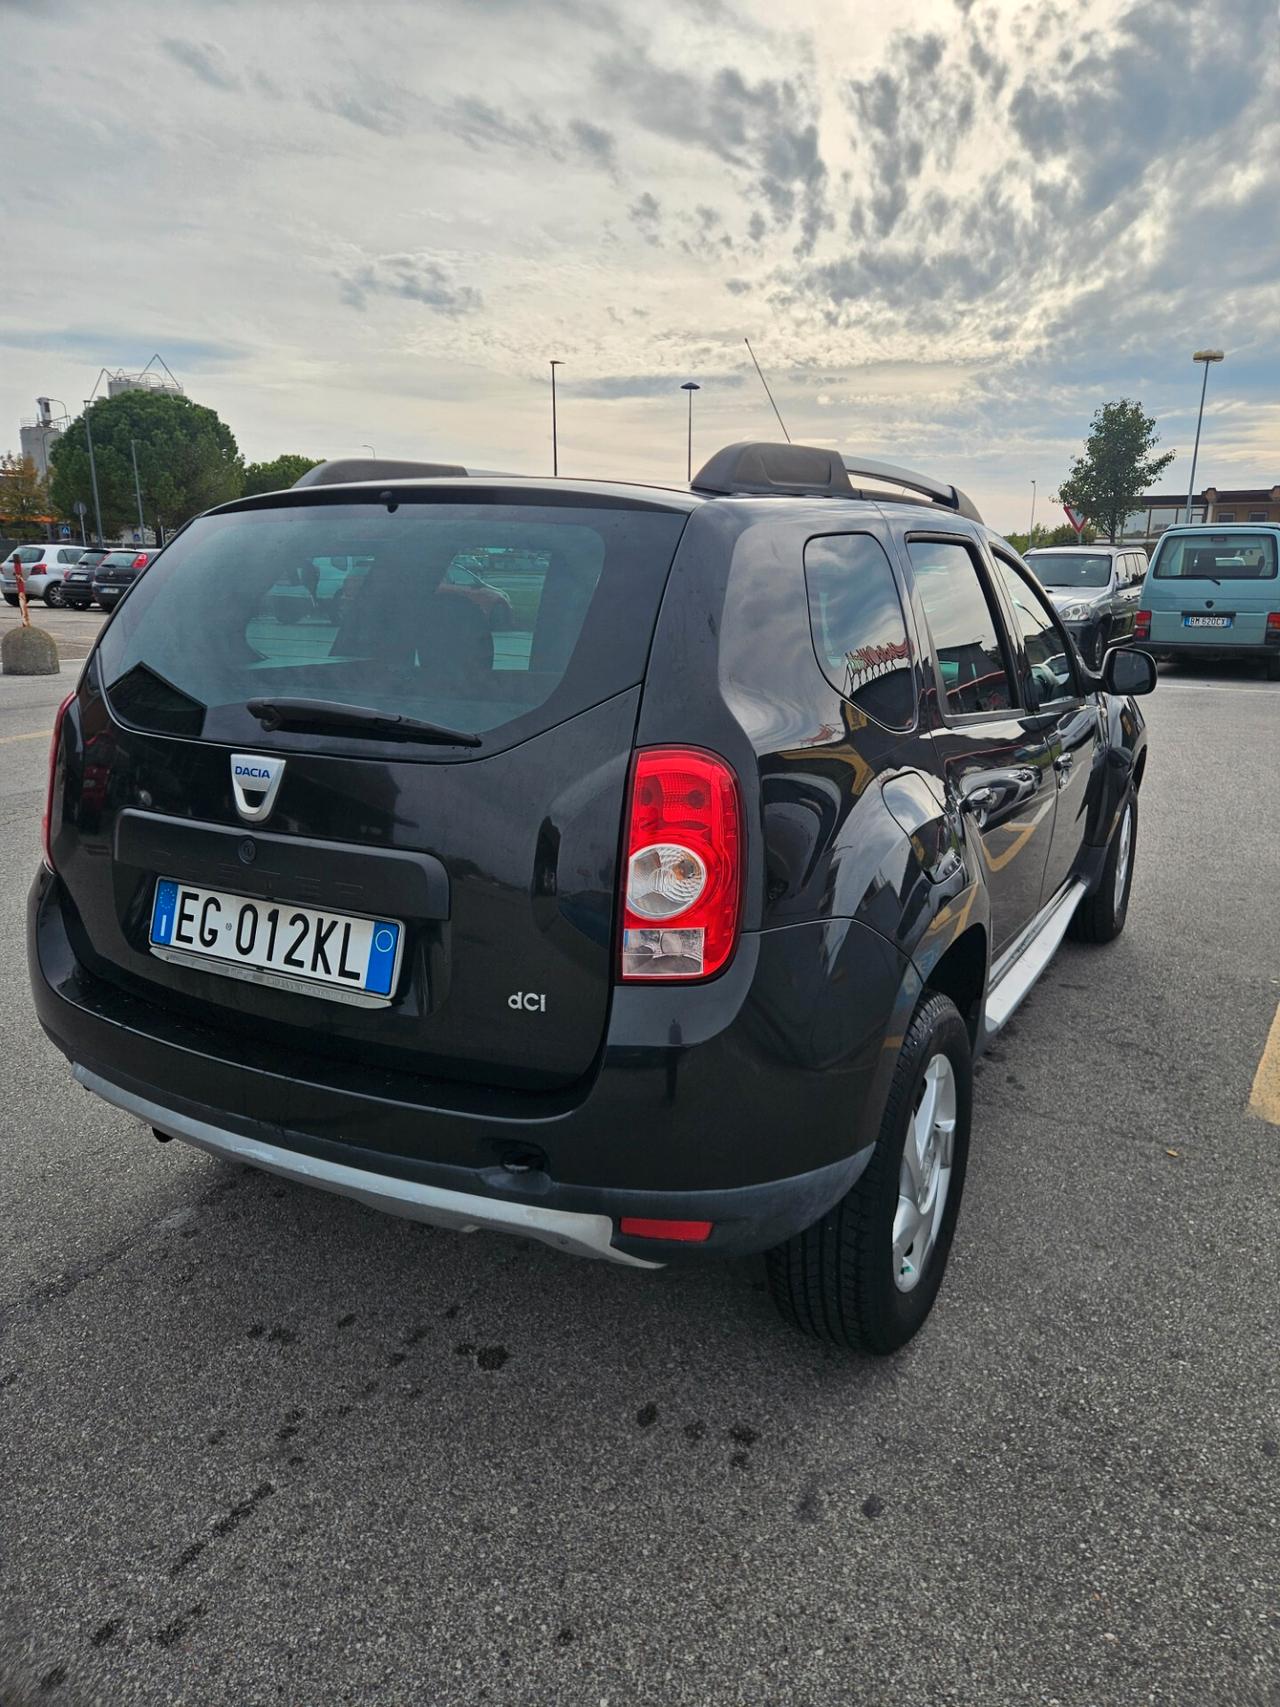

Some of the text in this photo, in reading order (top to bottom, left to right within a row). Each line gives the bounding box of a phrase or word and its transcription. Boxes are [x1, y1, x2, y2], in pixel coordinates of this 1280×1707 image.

[235, 766, 270, 779] DACIA
[175, 890, 222, 947] EG
[235, 903, 362, 981] 012KL
